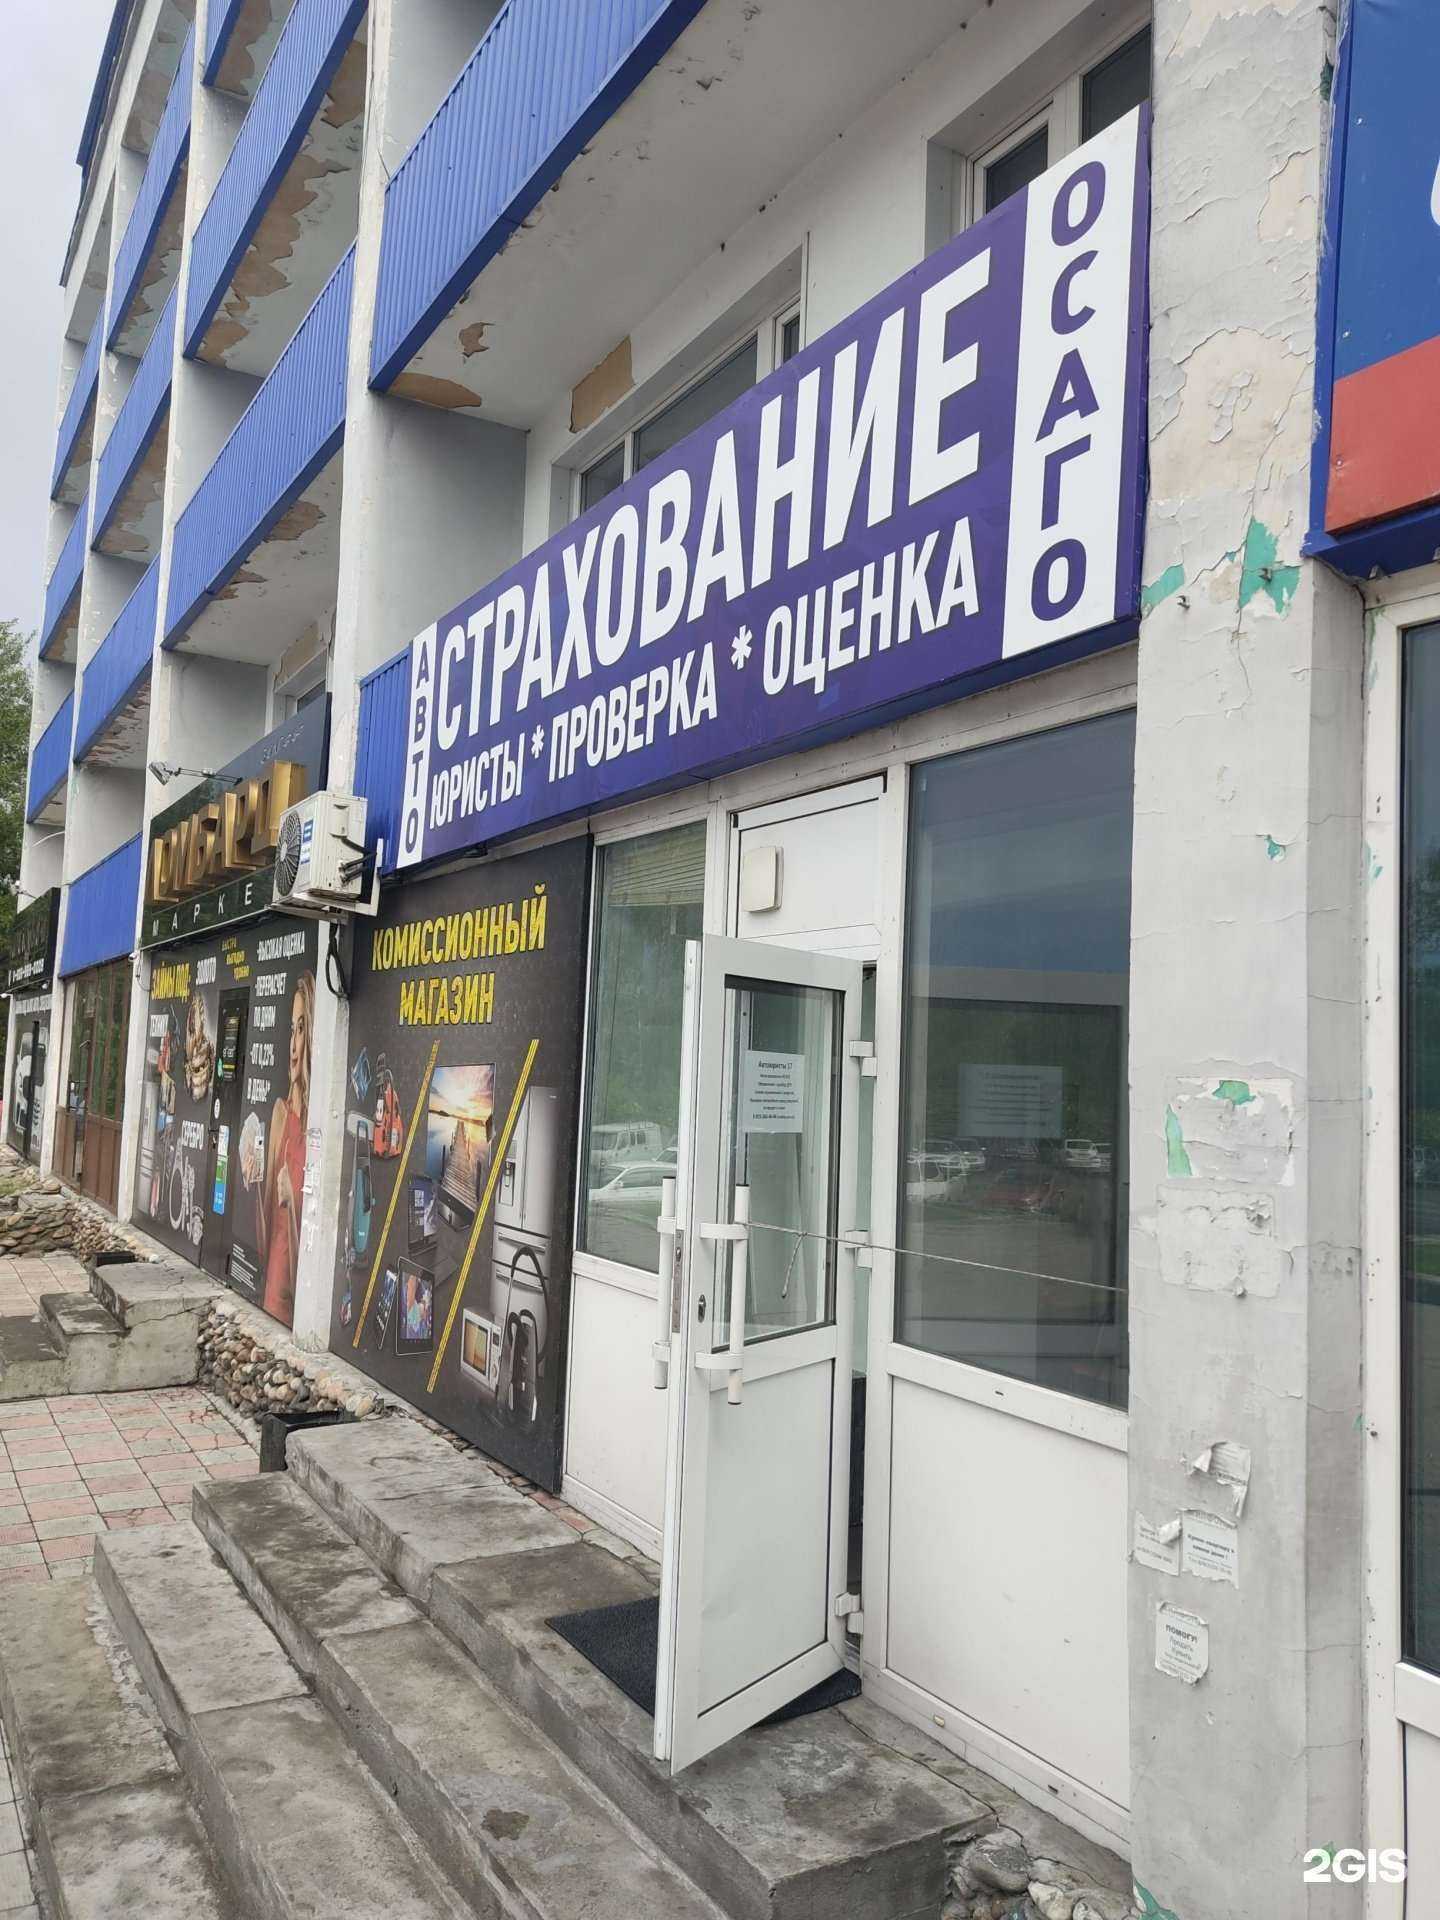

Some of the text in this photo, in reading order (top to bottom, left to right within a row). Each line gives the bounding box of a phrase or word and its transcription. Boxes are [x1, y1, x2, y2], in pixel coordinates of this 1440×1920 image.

[1030, 160, 1107, 622] ОСАГО
[437, 247, 991, 751] СТРАХОВАНИЕ
[762, 516, 979, 695] ОЦЕНКА
[405, 651, 430, 855] АВТО
[429, 641, 718, 830] ЮРИСТЫ ПРОВЕРКА
[152, 882, 253, 937] МАРКЕ
[372, 883, 548, 971] КОМИССИОННЫЙ
[399, 971, 496, 1026] МАГАЗИН
